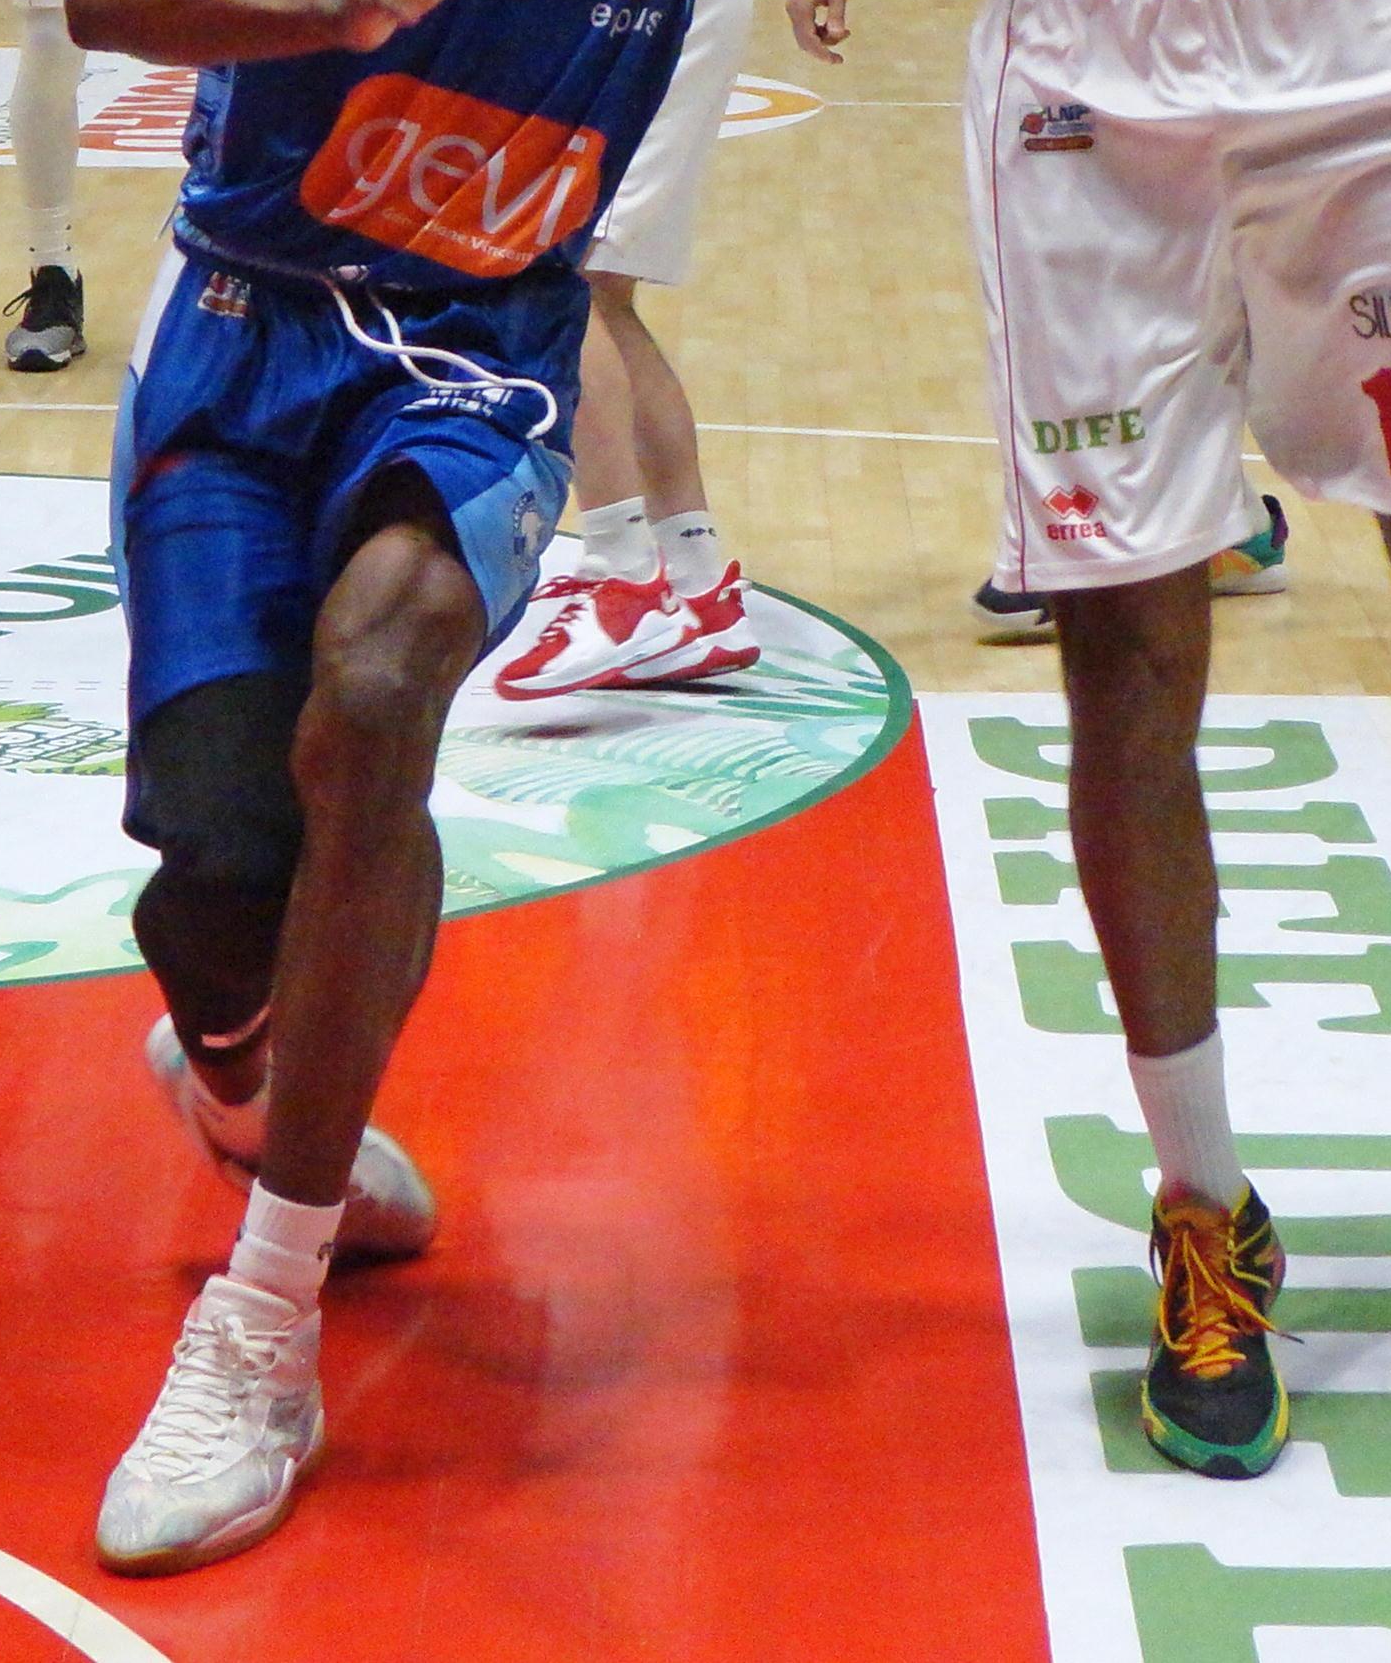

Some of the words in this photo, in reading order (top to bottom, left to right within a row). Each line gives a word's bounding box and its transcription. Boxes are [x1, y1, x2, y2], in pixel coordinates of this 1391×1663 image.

[590, 2, 663, 38] epis
[326, 117, 589, 247] gevi
[1032, 407, 1146, 455] DIFE
[1047, 514, 1106, 540] errea
